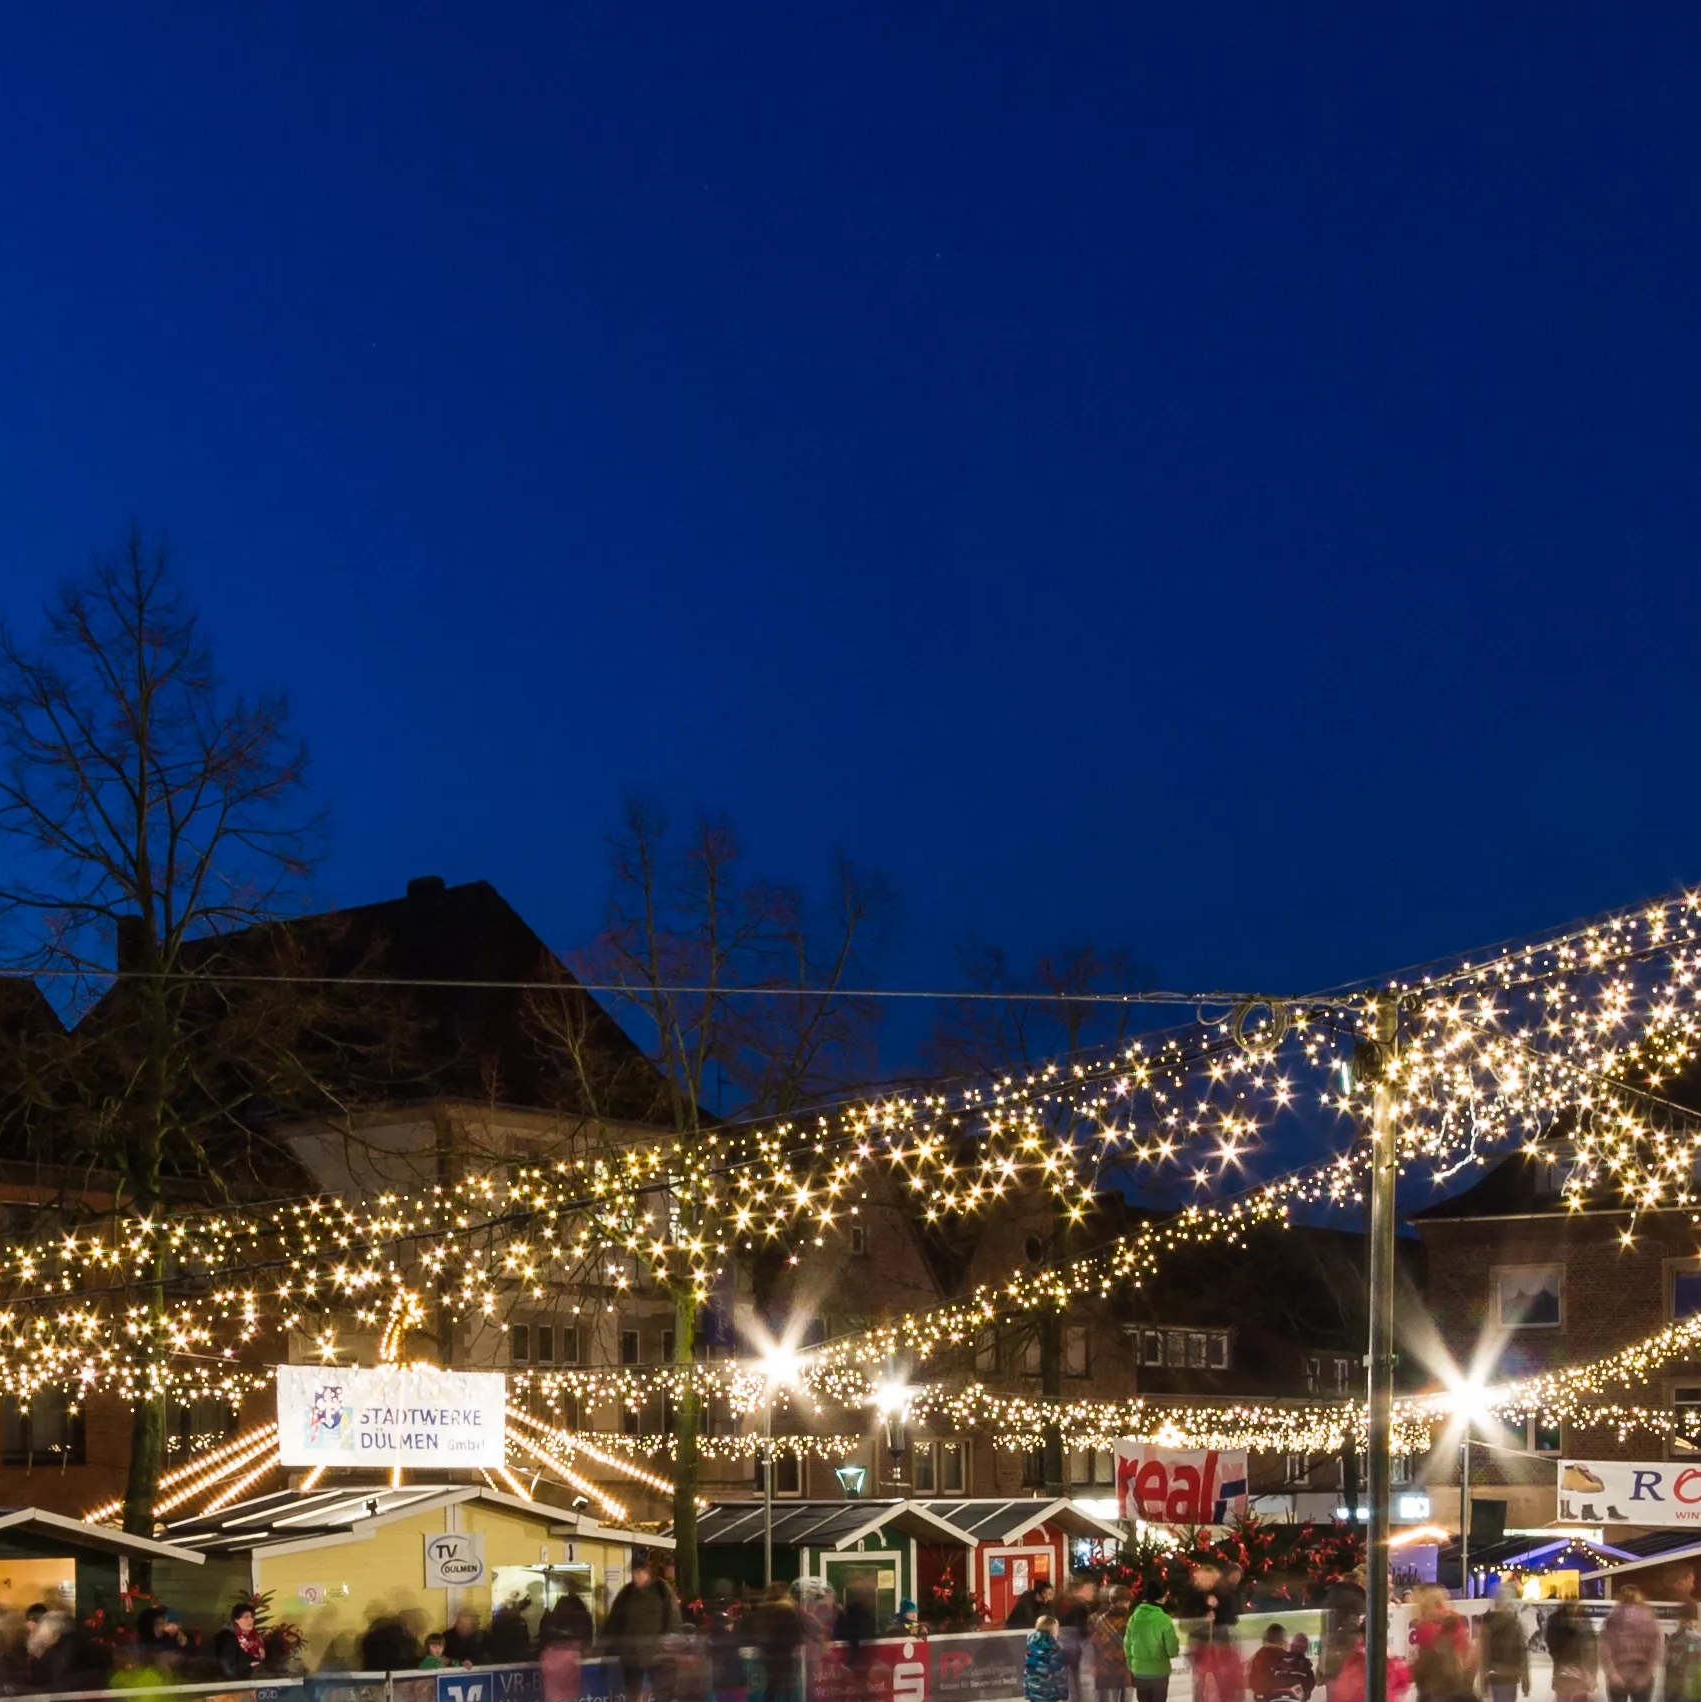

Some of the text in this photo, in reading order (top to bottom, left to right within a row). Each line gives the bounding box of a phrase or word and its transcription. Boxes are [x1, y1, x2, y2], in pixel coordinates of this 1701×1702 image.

[359, 1407, 483, 1427] STADTWERKE
[360, 1428, 439, 1450] DÜLMEN
[436, 1544, 458, 1559] TV
[444, 1563, 478, 1574] DÜLMEN
[499, 1671, 542, 1694] VR-B
